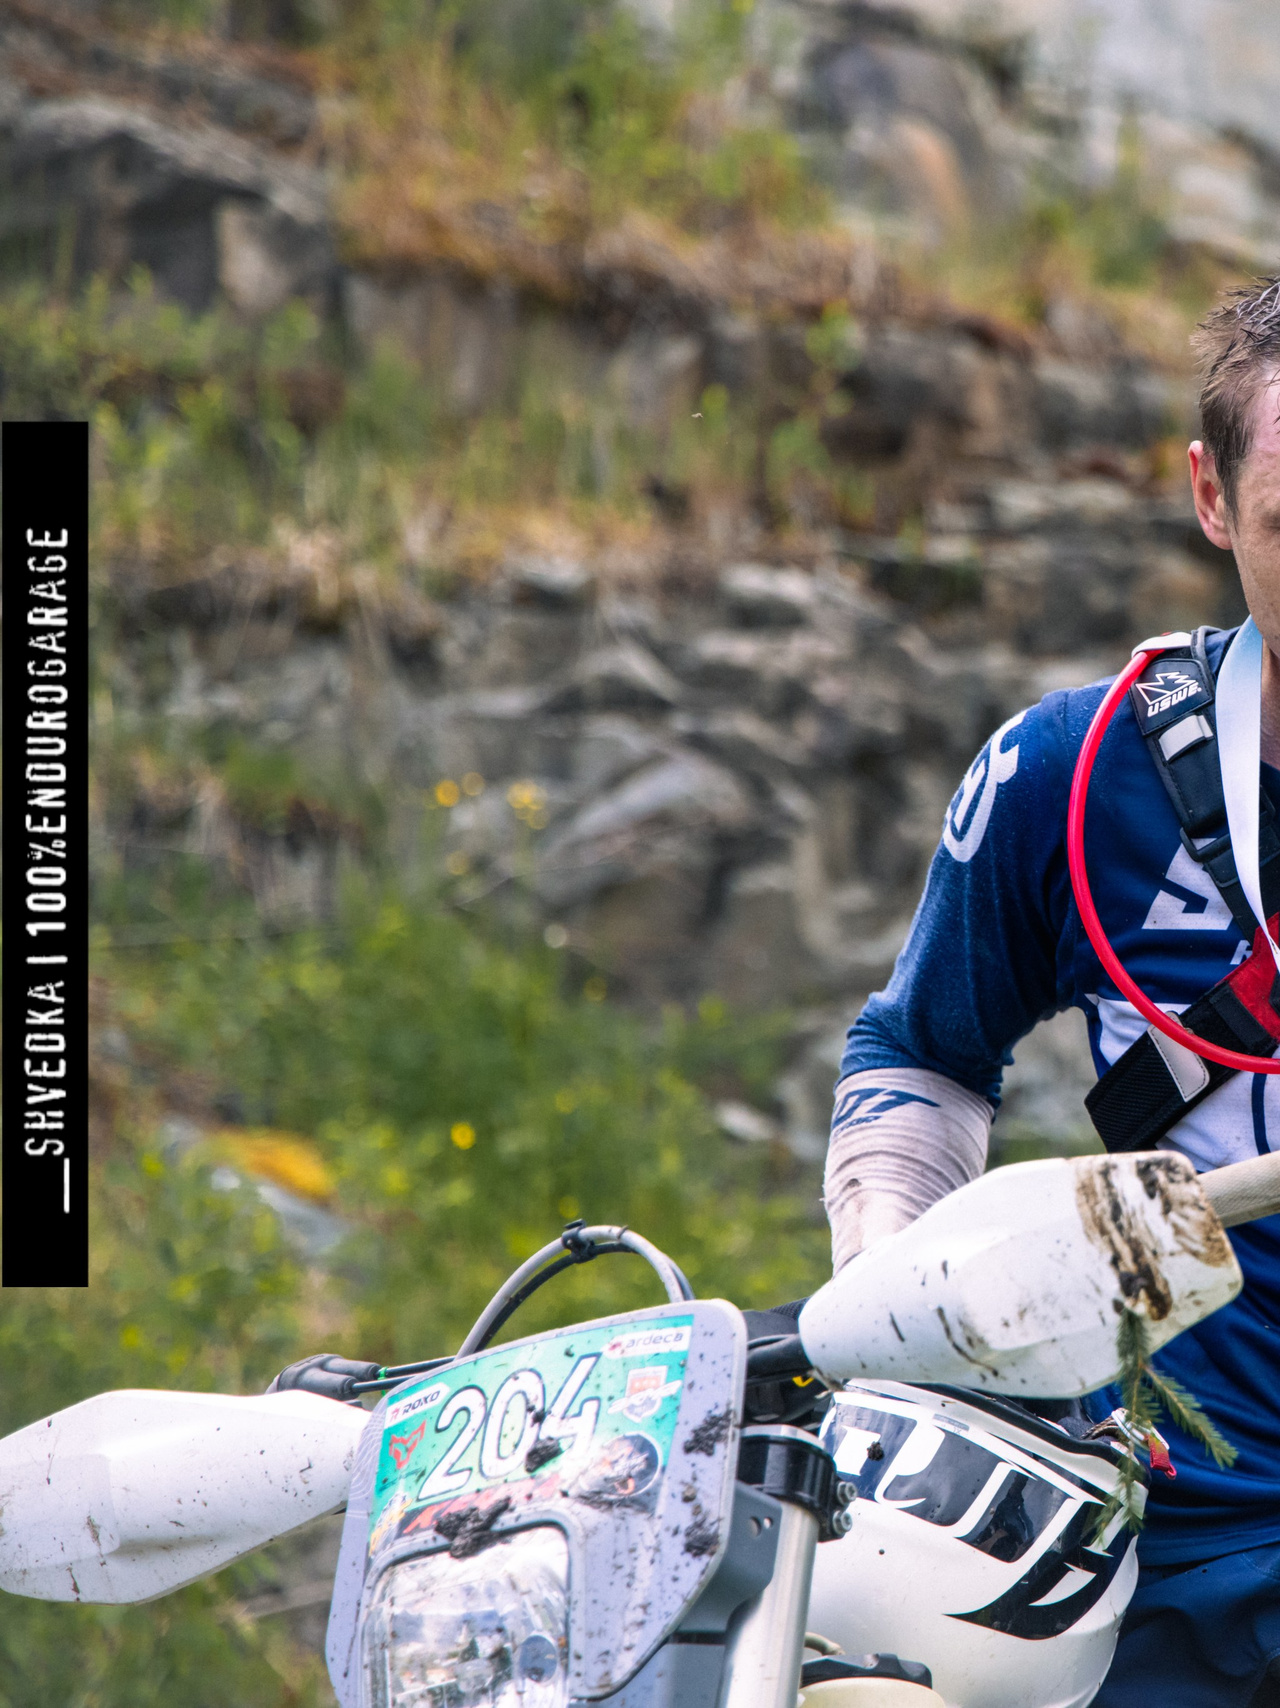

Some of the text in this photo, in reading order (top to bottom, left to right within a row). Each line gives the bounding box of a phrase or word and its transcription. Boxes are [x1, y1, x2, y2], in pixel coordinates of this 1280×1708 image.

[625, 1332, 684, 1349] ardeca
[402, 1389, 441, 1416] ROXO
[416, 1352, 602, 1502] 204
